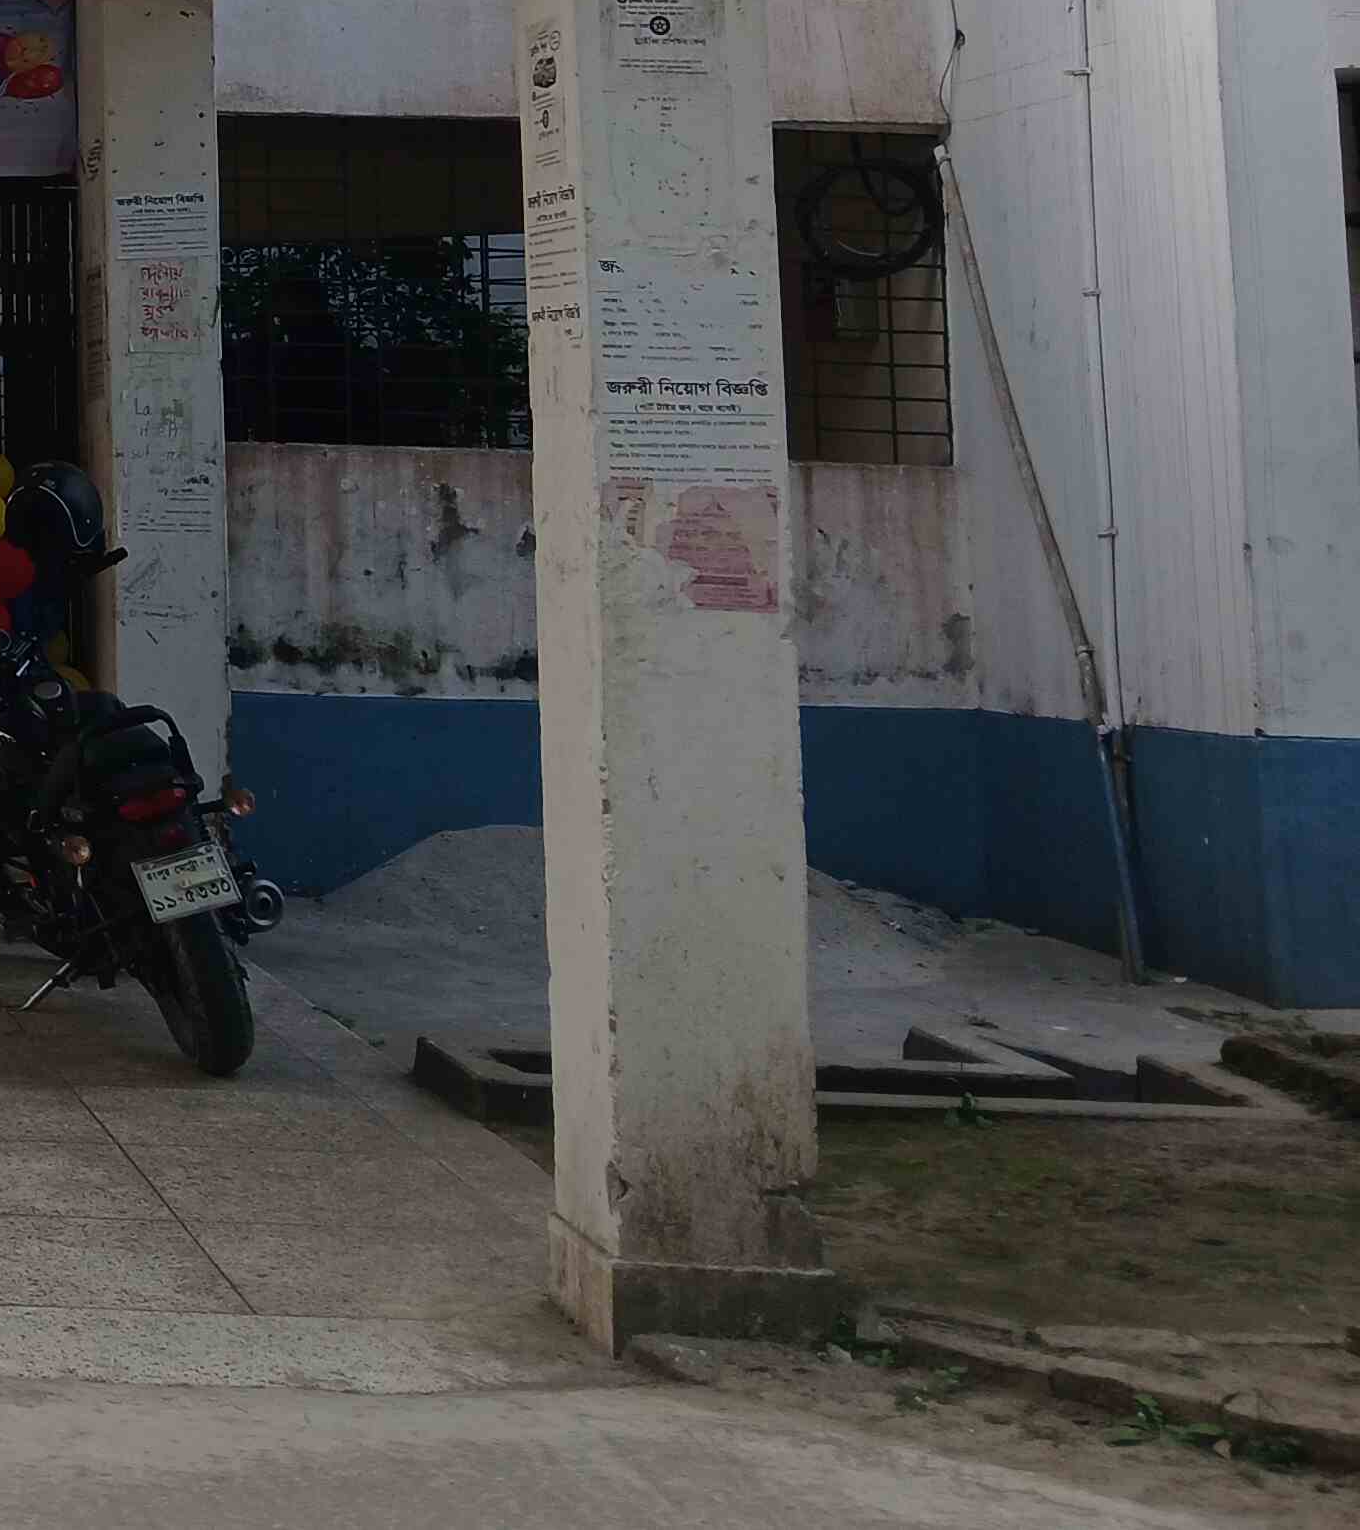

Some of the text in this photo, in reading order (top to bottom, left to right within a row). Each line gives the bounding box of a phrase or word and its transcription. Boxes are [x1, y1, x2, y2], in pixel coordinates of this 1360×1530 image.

[606, 377, 768, 397] জরুরী নিয়োগ বিজ্ঞপ্তি
